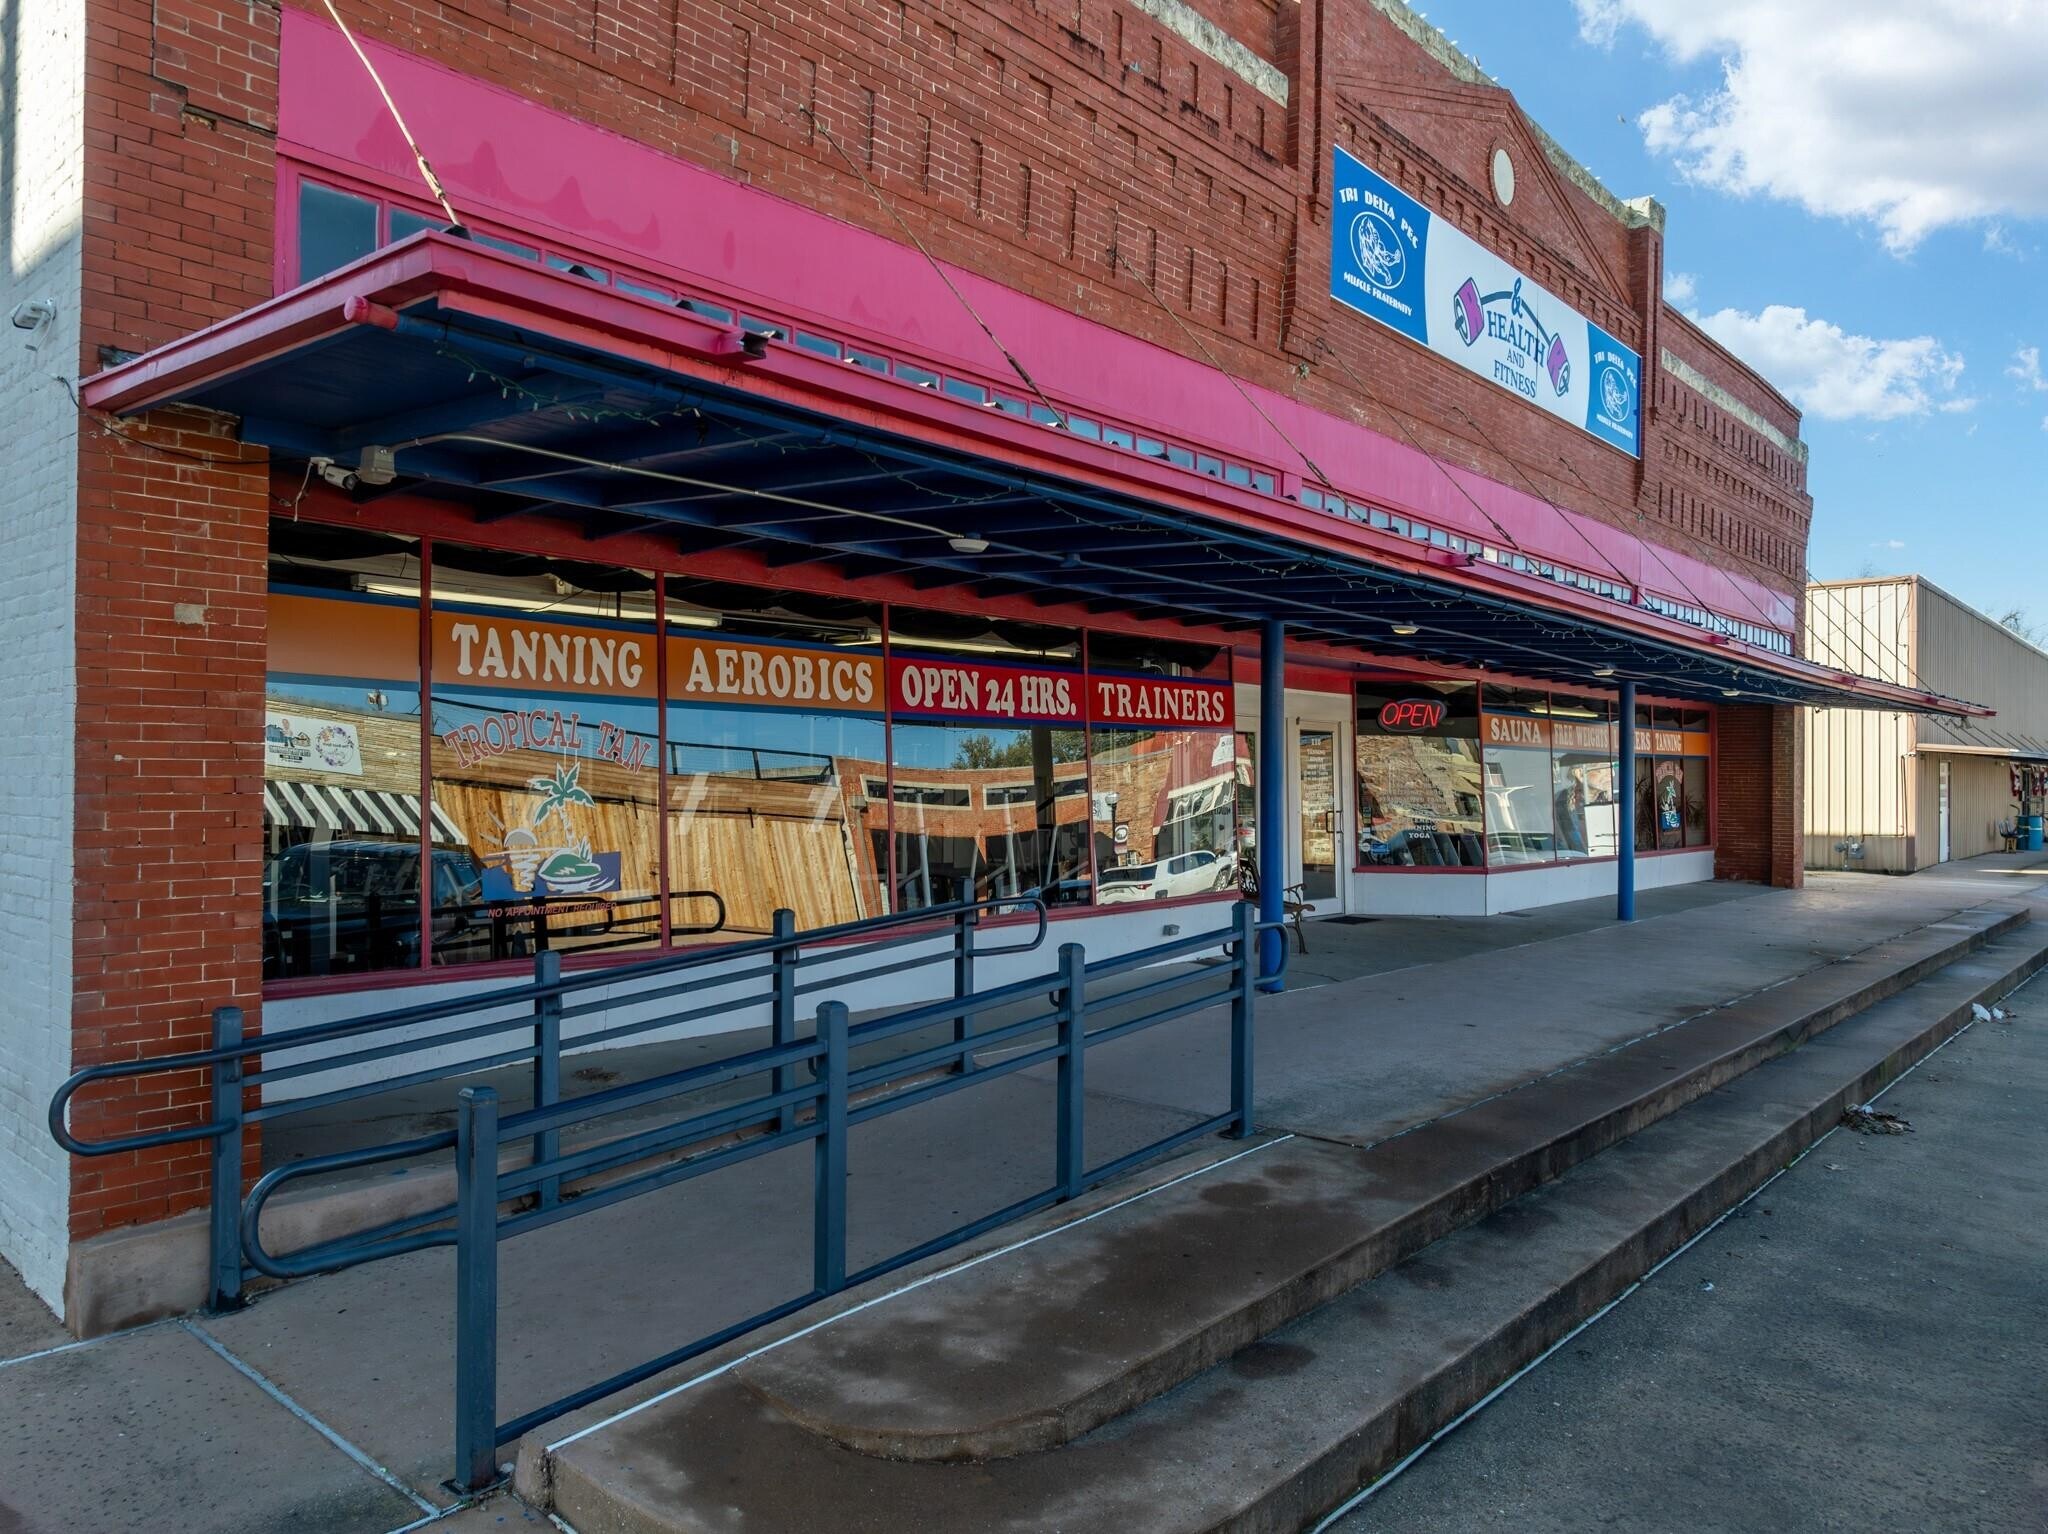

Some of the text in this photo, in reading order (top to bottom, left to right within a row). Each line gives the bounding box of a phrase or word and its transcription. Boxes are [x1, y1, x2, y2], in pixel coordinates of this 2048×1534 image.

[1339, 187, 1419, 249] TRI DELTA PEC
[1343, 271, 1413, 317] MUSCLE FRATERNITY
[1511, 277, 1523, 319] &
[1486, 310, 1546, 368] HEALTH
[1506, 347, 1525, 369] AND
[1493, 359, 1537, 398] FITNESS
[450, 621, 644, 688] TANNING
[685, 647, 874, 704] AEROBICS
[901, 664, 1077, 718] OPEN 24 HRS.
[1098, 682, 1225, 724] TRAINERS
[1381, 702, 1440, 728] OPEN
[1490, 718, 1541, 744] SAUNA
[442, 709, 651, 775] TROPICAL TAN
[1553, 724, 1608, 749] FREE WEIGHTS
[1655, 733, 1682, 751] TANNING
[487, 902, 617, 918] NO APPOINTMENT REQUIRED
